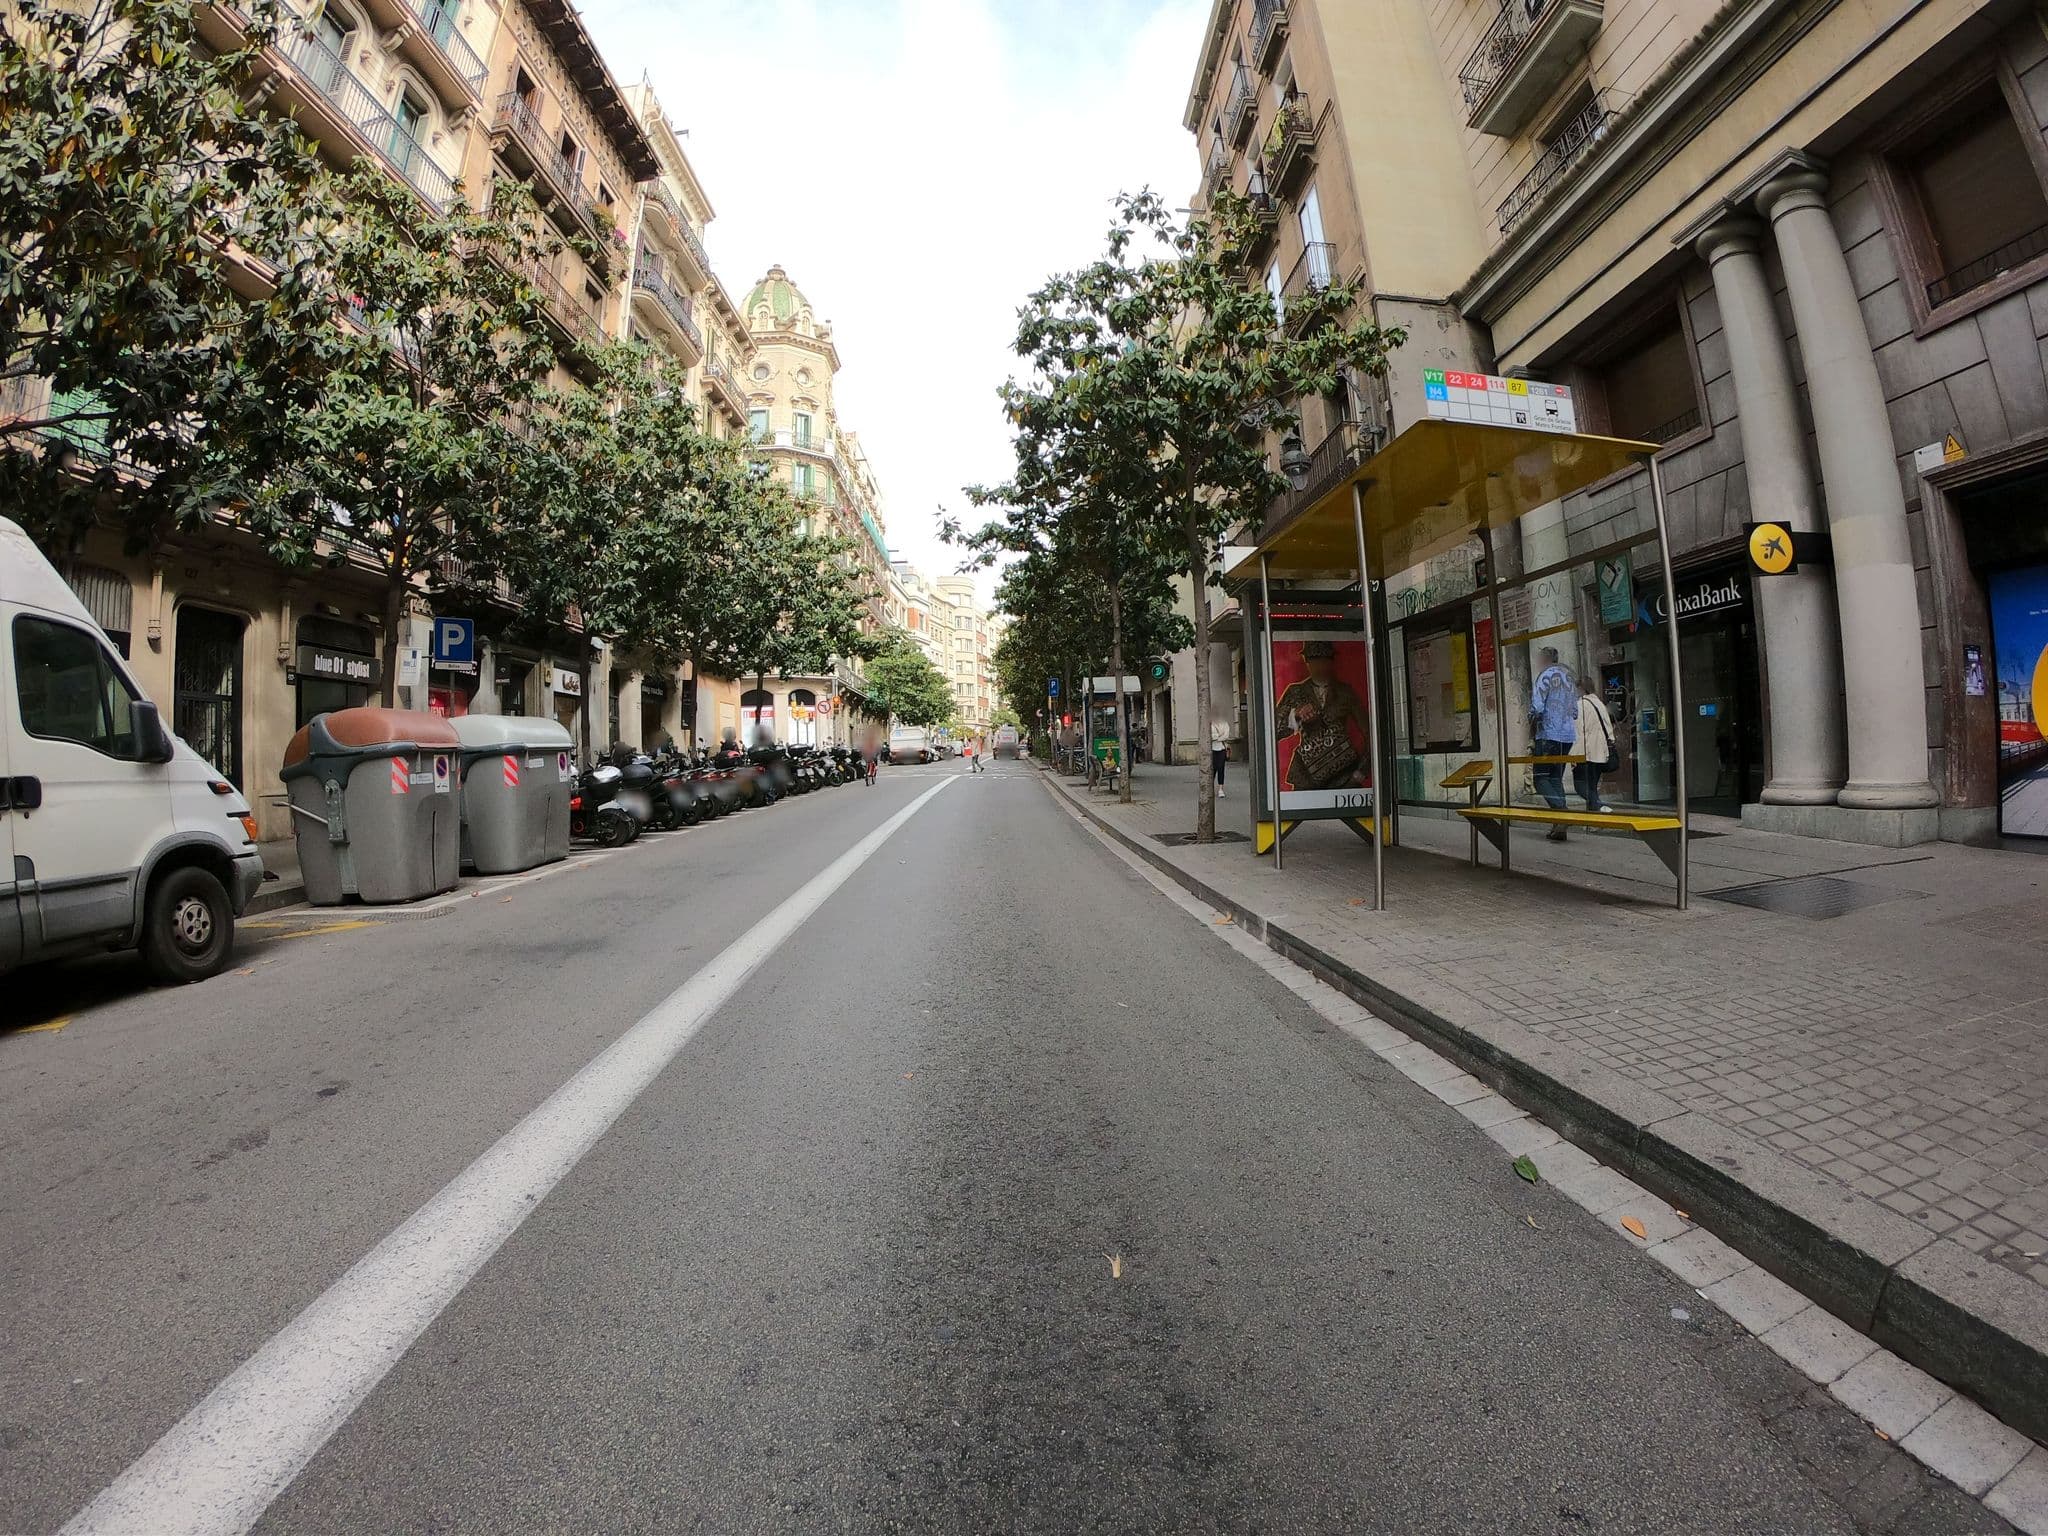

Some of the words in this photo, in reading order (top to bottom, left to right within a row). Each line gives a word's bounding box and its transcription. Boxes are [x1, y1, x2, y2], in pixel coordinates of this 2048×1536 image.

[1424, 370, 1443, 382] V17
[1449, 374, 1462, 385] 22
[1470, 377, 1483, 387] 24
[1489, 379, 1505, 390] 114
[1511, 382, 1522, 392] 87
[1429, 386, 1442, 396] N4
[1656, 577, 1742, 617] CixaBank
[442, 623, 465, 656] P
[314, 654, 333, 672] blue
[333, 657, 344, 673] 01
[347, 661, 370, 678] stylist
[1335, 794, 1374, 808] DIOR
